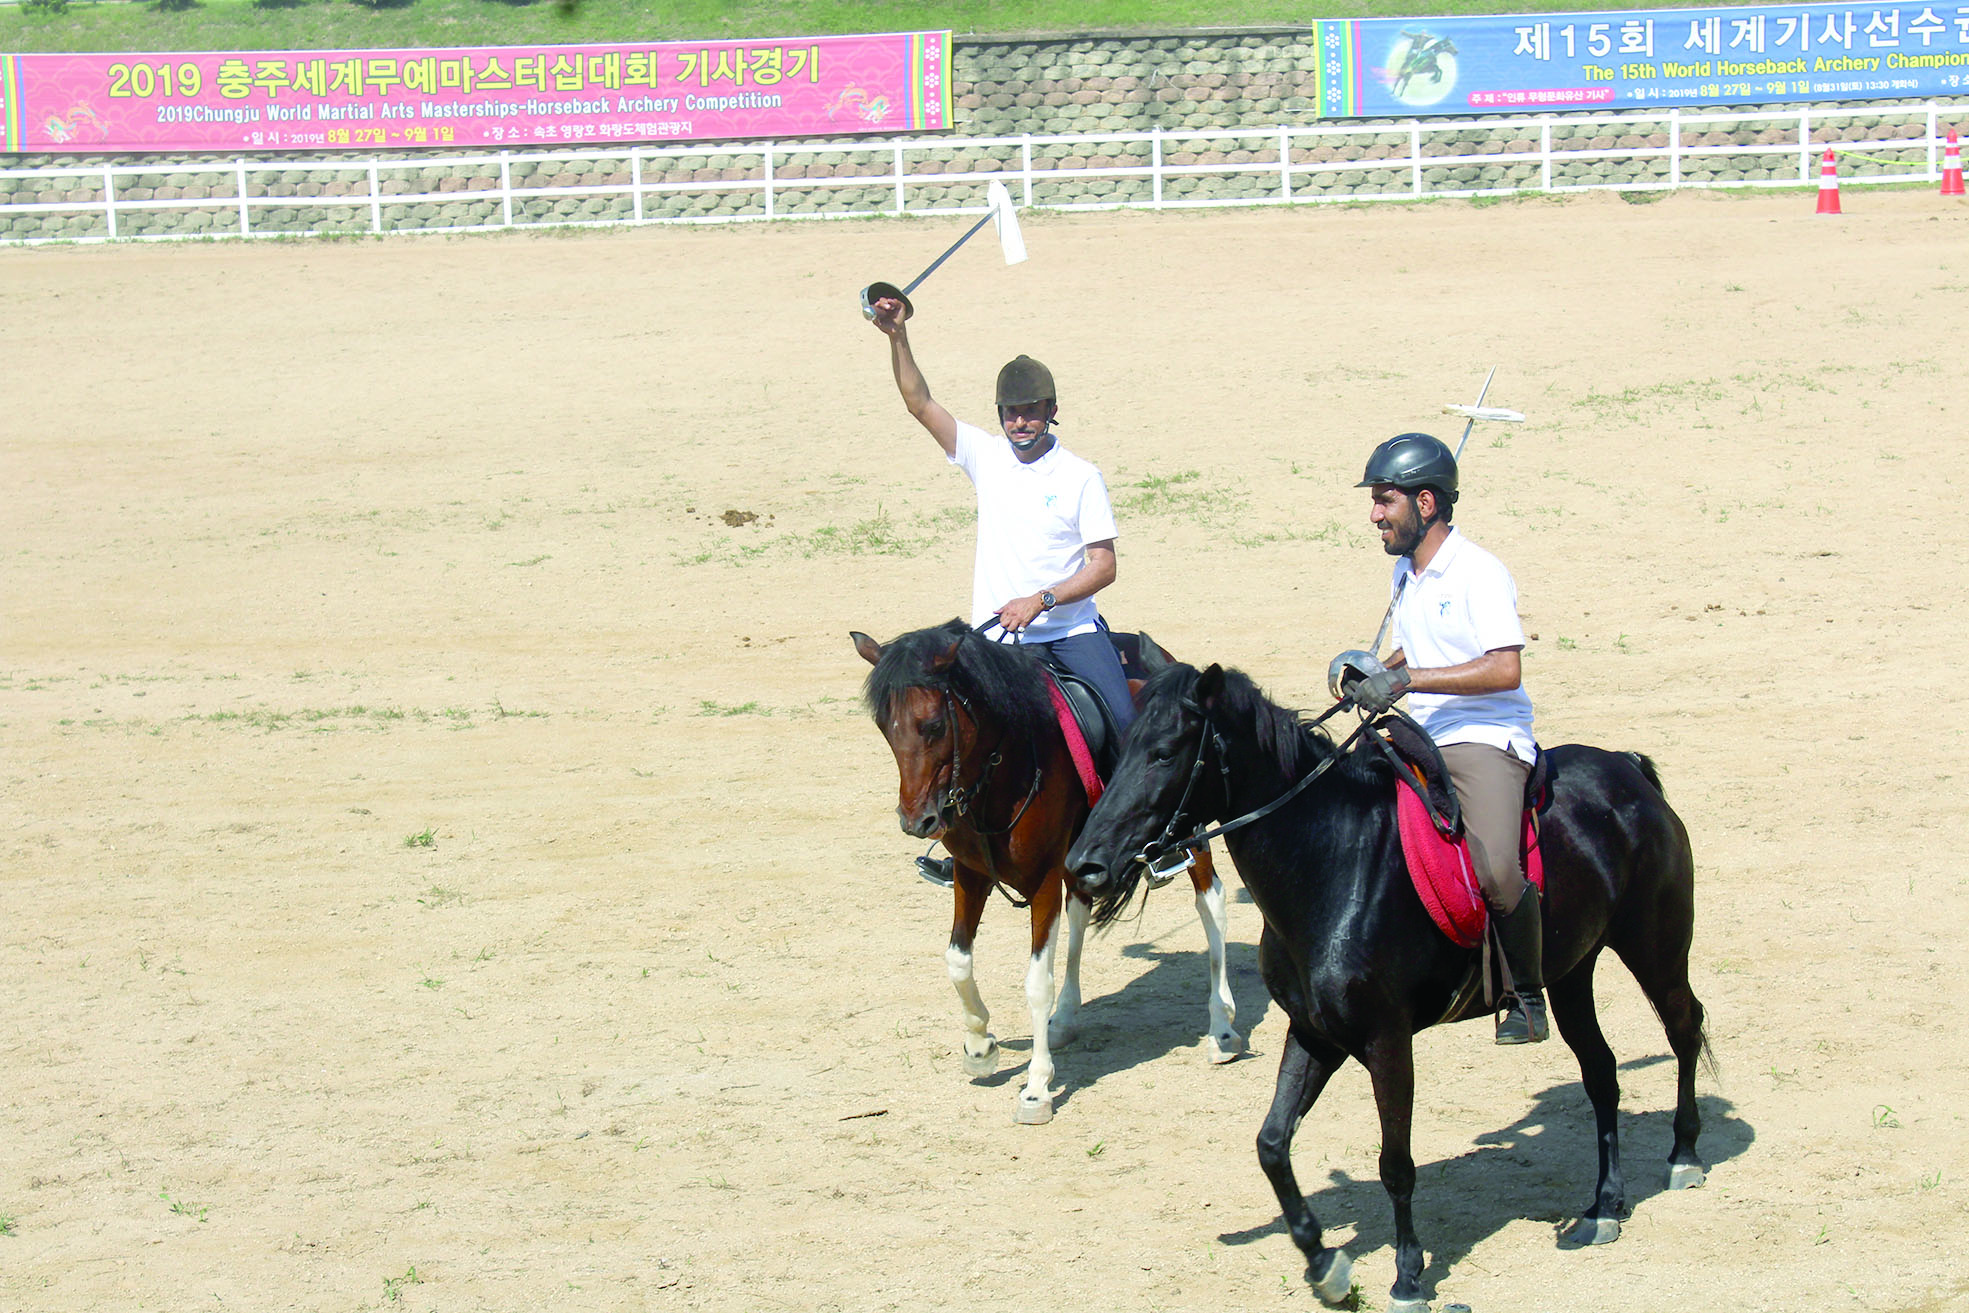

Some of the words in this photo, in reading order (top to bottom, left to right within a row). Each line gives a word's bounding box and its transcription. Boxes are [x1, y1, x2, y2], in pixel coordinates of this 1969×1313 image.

[1513, 19, 1654, 60] 제15회
[108, 62, 202, 98] 2019
[216, 51, 658, 99] 충주세계무예마스터십대회
[675, 45, 819, 87] 기사경기
[1582, 65, 1614, 81] The
[1620, 62, 1657, 80] 15th
[1663, 61, 1711, 78] World
[1717, 57, 1807, 76] Horseback
[1813, 55, 1880, 73] Archery
[1634, 88, 1646, 100] 일
[1648, 87, 1659, 99] 시
[1668, 87, 1698, 98] 2019년
[1700, 83, 1720, 97] 8월
[1723, 82, 1751, 97] 27일
[1766, 80, 1786, 95] 9월
[1791, 80, 1810, 94] 1일
[1865, 80, 1890, 91] 13:30
[1949, 74, 1960, 88] 장
[157, 105, 260, 123] 2019Chungju
[266, 103, 312, 121] World
[318, 103, 374, 121] Martial
[380, 101, 415, 119] Arts
[421, 97, 610, 120] Masterships-Horseback
[617, 95, 679, 114] Archery
[685, 92, 782, 112] Competition
[251, 131, 264, 145] 일
[268, 132, 280, 145] 시
[290, 133, 325, 145] 2019년
[327, 129, 350, 144] 8월
[354, 127, 387, 143] 27일
[404, 126, 428, 142] 9월
[433, 126, 454, 141] 1일
[492, 127, 504, 140] 장
[508, 126, 520, 138] 소
[534, 126, 557, 138] 속초
[560, 123, 596, 139] 영랑호
[599, 121, 692, 136] 화랑도체험관광지
